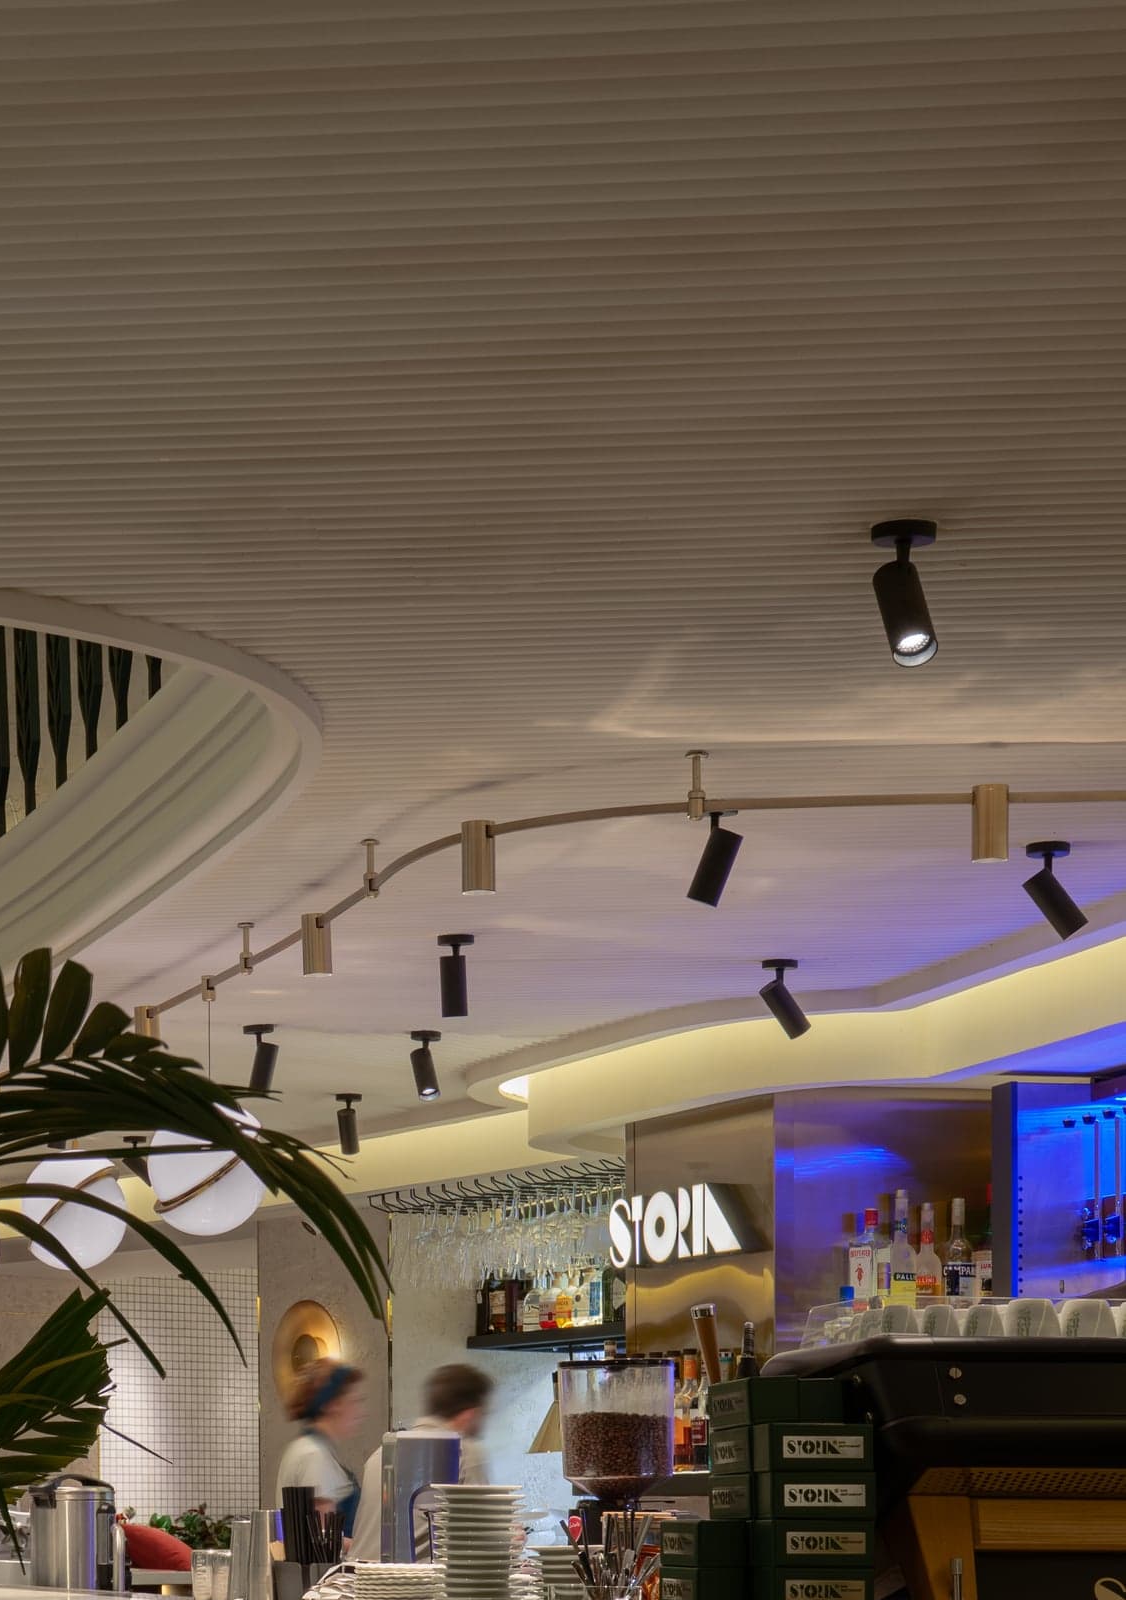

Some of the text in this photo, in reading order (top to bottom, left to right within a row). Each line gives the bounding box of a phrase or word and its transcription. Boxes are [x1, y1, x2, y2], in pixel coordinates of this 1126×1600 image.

[609, 1182, 743, 1269] STORIA
[787, 1439, 841, 1455] STORIA
[788, 1488, 843, 1503] STORIA
